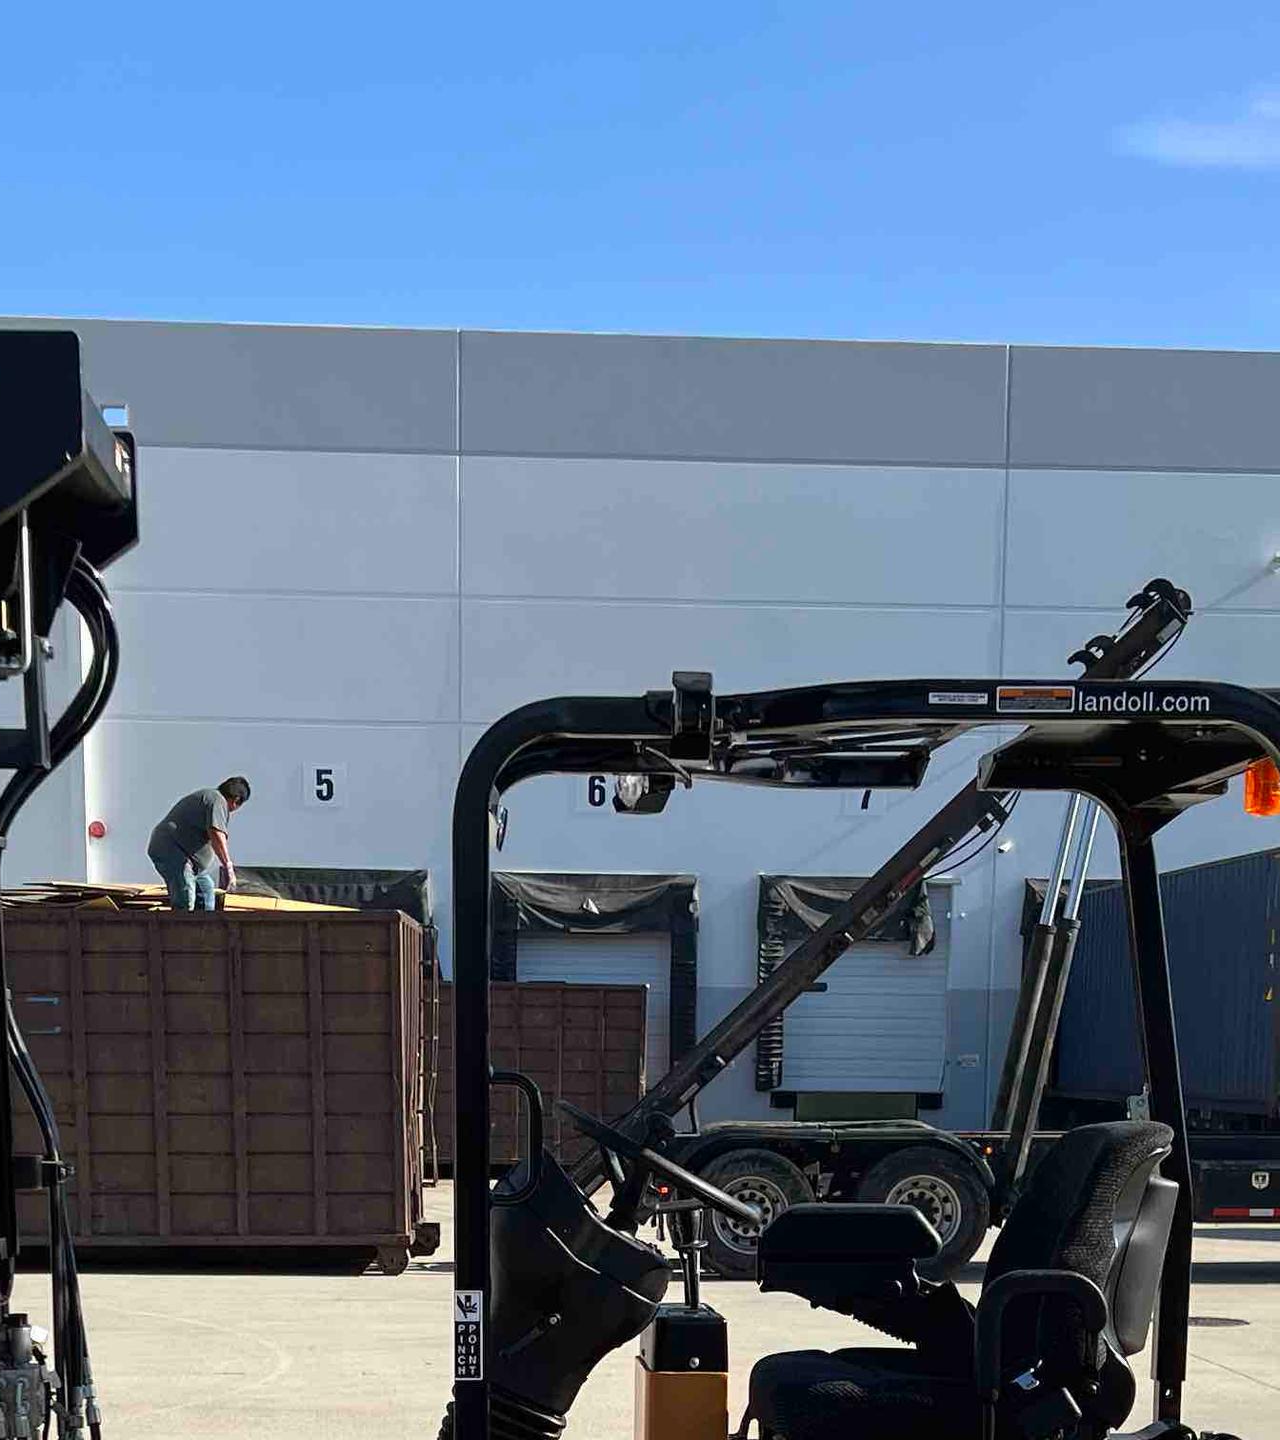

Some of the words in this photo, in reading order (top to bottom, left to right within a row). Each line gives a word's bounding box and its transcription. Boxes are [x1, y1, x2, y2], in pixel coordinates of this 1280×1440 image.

[1078, 691, 1210, 713] landoll.com
[315, 768, 334, 802] 5
[588, 775, 607, 807] 6
[457, 1324, 466, 1375] PINCH
[468, 1324, 477, 1375] POINT
